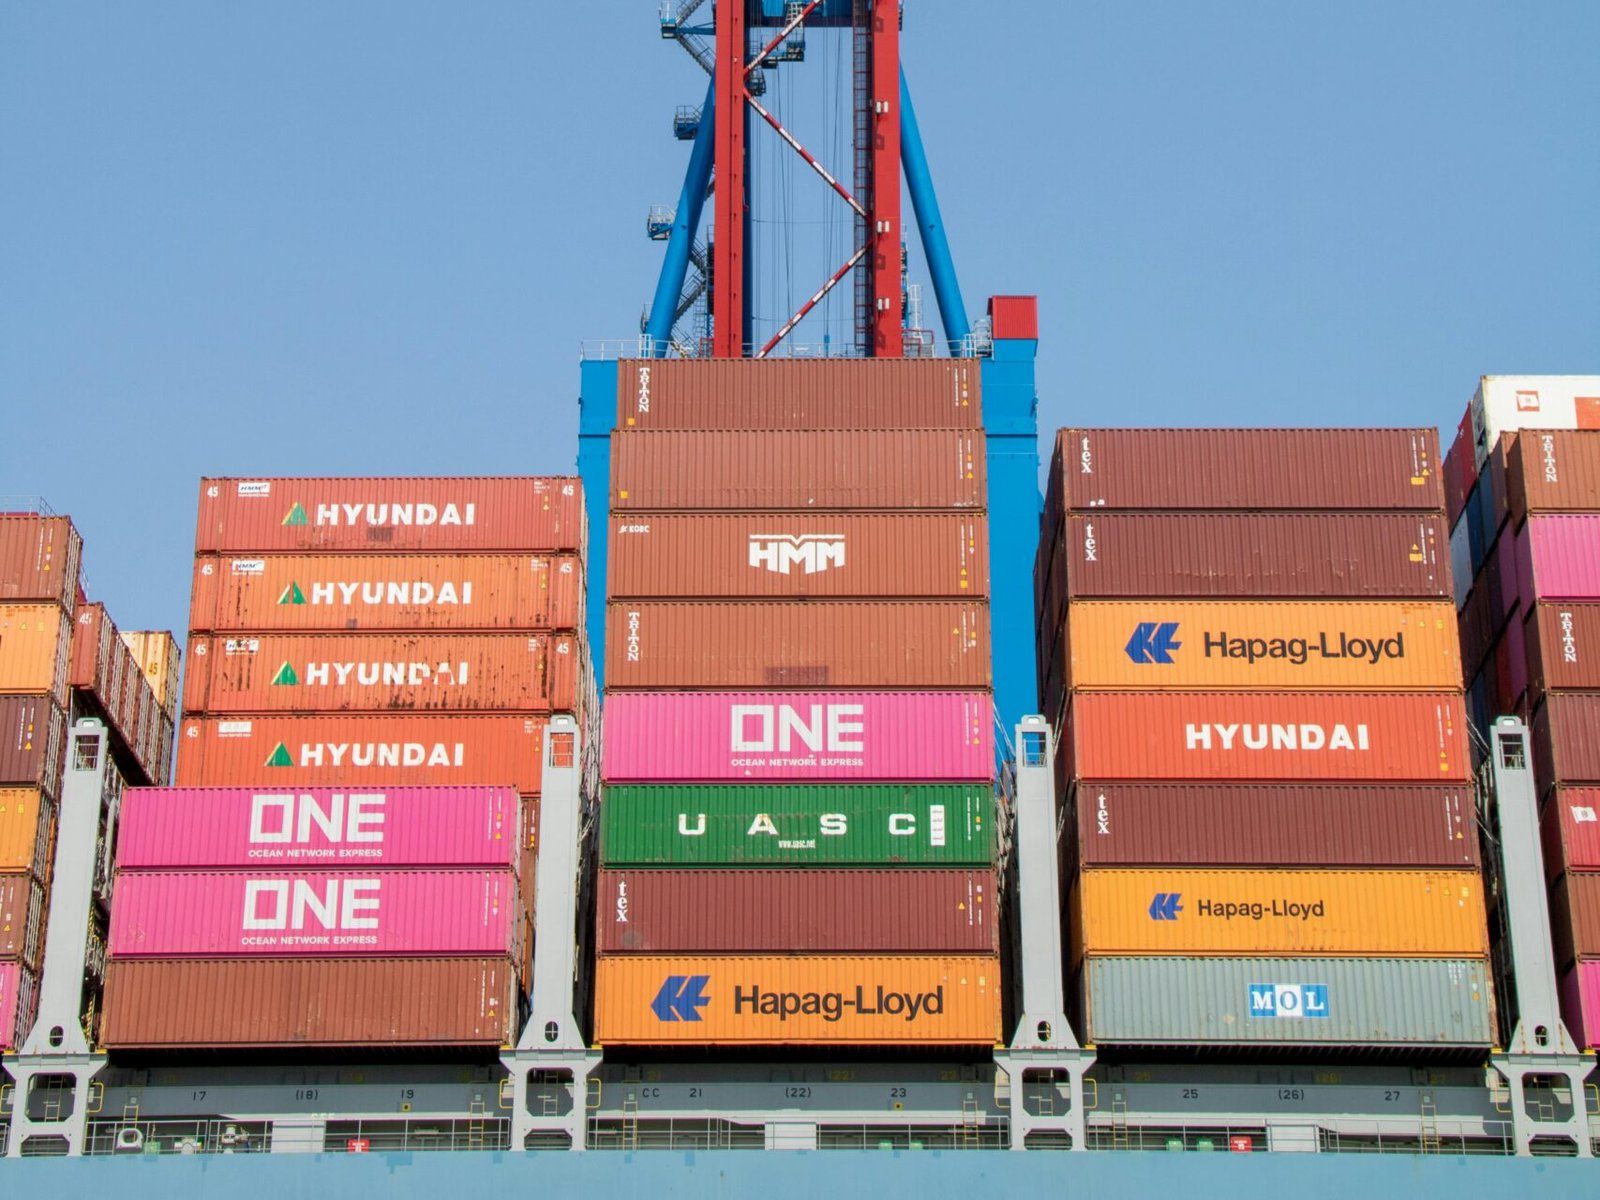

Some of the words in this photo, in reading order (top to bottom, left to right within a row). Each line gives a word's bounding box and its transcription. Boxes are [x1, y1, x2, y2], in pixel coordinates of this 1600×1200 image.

[638, 367, 650, 413] TRITON
[1081, 437, 1092, 473] tex
[1541, 435, 1557, 482] TRITON
[207, 486, 219, 497] 45
[562, 485, 574, 496] 45
[316, 503, 475, 526] HYUNDAI
[629, 525, 650, 533] KOBC
[1085, 523, 1097, 561] tex
[749, 534, 846, 575] HMM
[201, 564, 213, 575] 45
[559, 563, 572, 574] 45
[312, 582, 472, 605] HYUNDAI
[79, 612, 92, 625] 45
[628, 612, 640, 661] TRITON
[1560, 612, 1577, 662] TRITON
[195, 644, 206, 655] 45
[557, 643, 569, 654] 45
[1204, 631, 1405, 664] Hapag-Lloyd
[149, 662, 158, 675] 45
[306, 662, 469, 685] HYUNDAI
[186, 726, 198, 738] 45
[731, 704, 864, 752] ONE
[1186, 724, 1370, 750] HYUNDAI
[300, 743, 464, 767] HYUNDAI
[731, 758, 765, 767] OCEAN
[769, 758, 817, 767] NETWORK
[821, 758, 864, 767] EXPRESS
[249, 794, 386, 843] ONE
[1098, 794, 1110, 834] tex
[248, 849, 283, 858] OCEAN
[287, 849, 335, 858] NETWORK
[339, 849, 383, 857] EXPRESS
[242, 879, 381, 930] ONE
[616, 881, 628, 922] tex
[1198, 899, 1325, 920] Hapag-Lloyd
[241, 937, 277, 945] OCEAN
[280, 936, 330, 945] NETWORK
[333, 936, 378, 945] EXPRESS
[734, 985, 943, 1021] Hapag-Lloyd
[1251, 990, 1325, 1011] MOL
[193, 1090, 207, 1101] 17
[295, 1089, 319, 1101] (18)
[401, 1089, 415, 1100] 19
[689, 1088, 703, 1098] 21
[785, 1087, 811, 1099] (22)
[890, 1088, 907, 1098] 23
[1182, 1089, 1199, 1099] 25
[1278, 1088, 1305, 1100] (26)
[1384, 1091, 1401, 1101] 27
